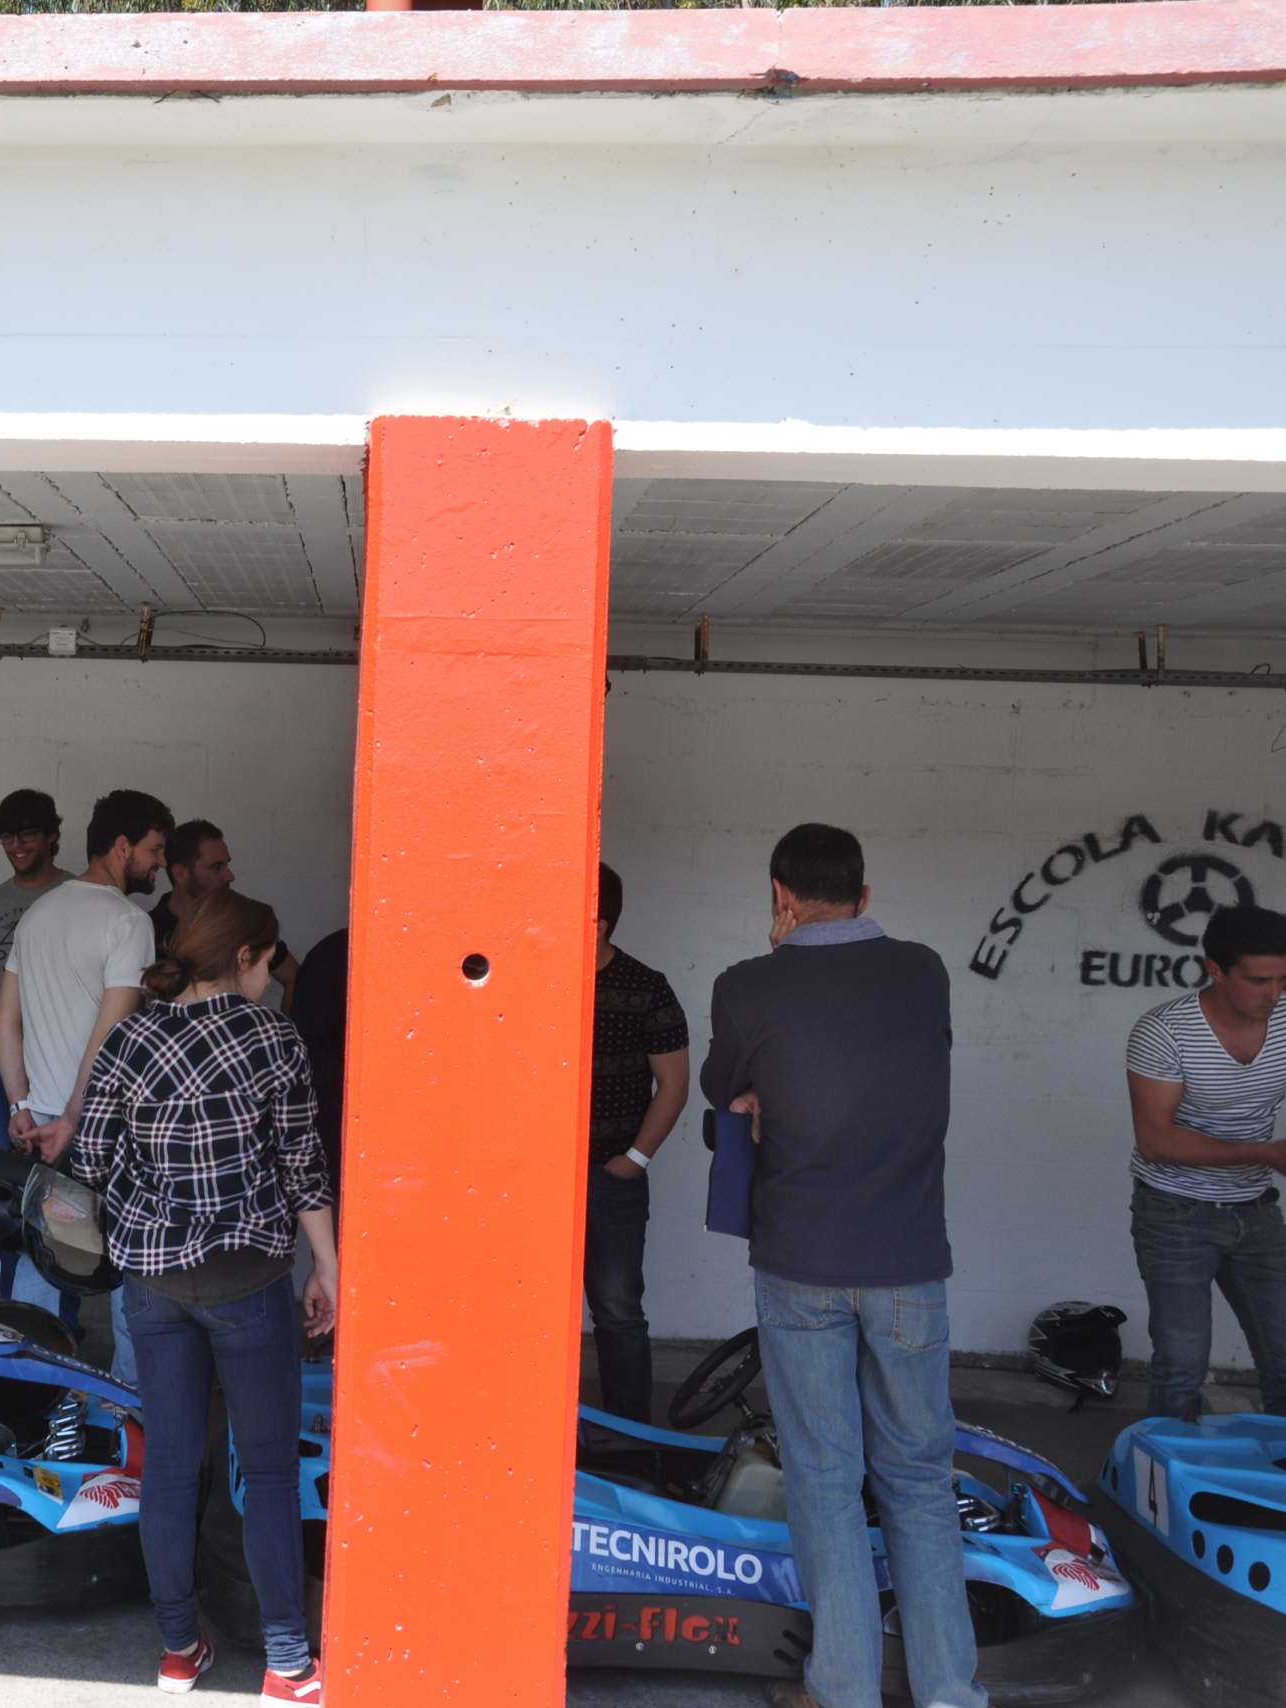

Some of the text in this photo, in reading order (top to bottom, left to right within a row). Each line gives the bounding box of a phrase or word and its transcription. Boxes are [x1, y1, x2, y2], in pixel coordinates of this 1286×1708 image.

[969, 813, 1162, 980] ESCOLA
[572, 1521, 763, 1585] TECNIROLO
[591, 1562, 651, 1581] ENGENHARIA
